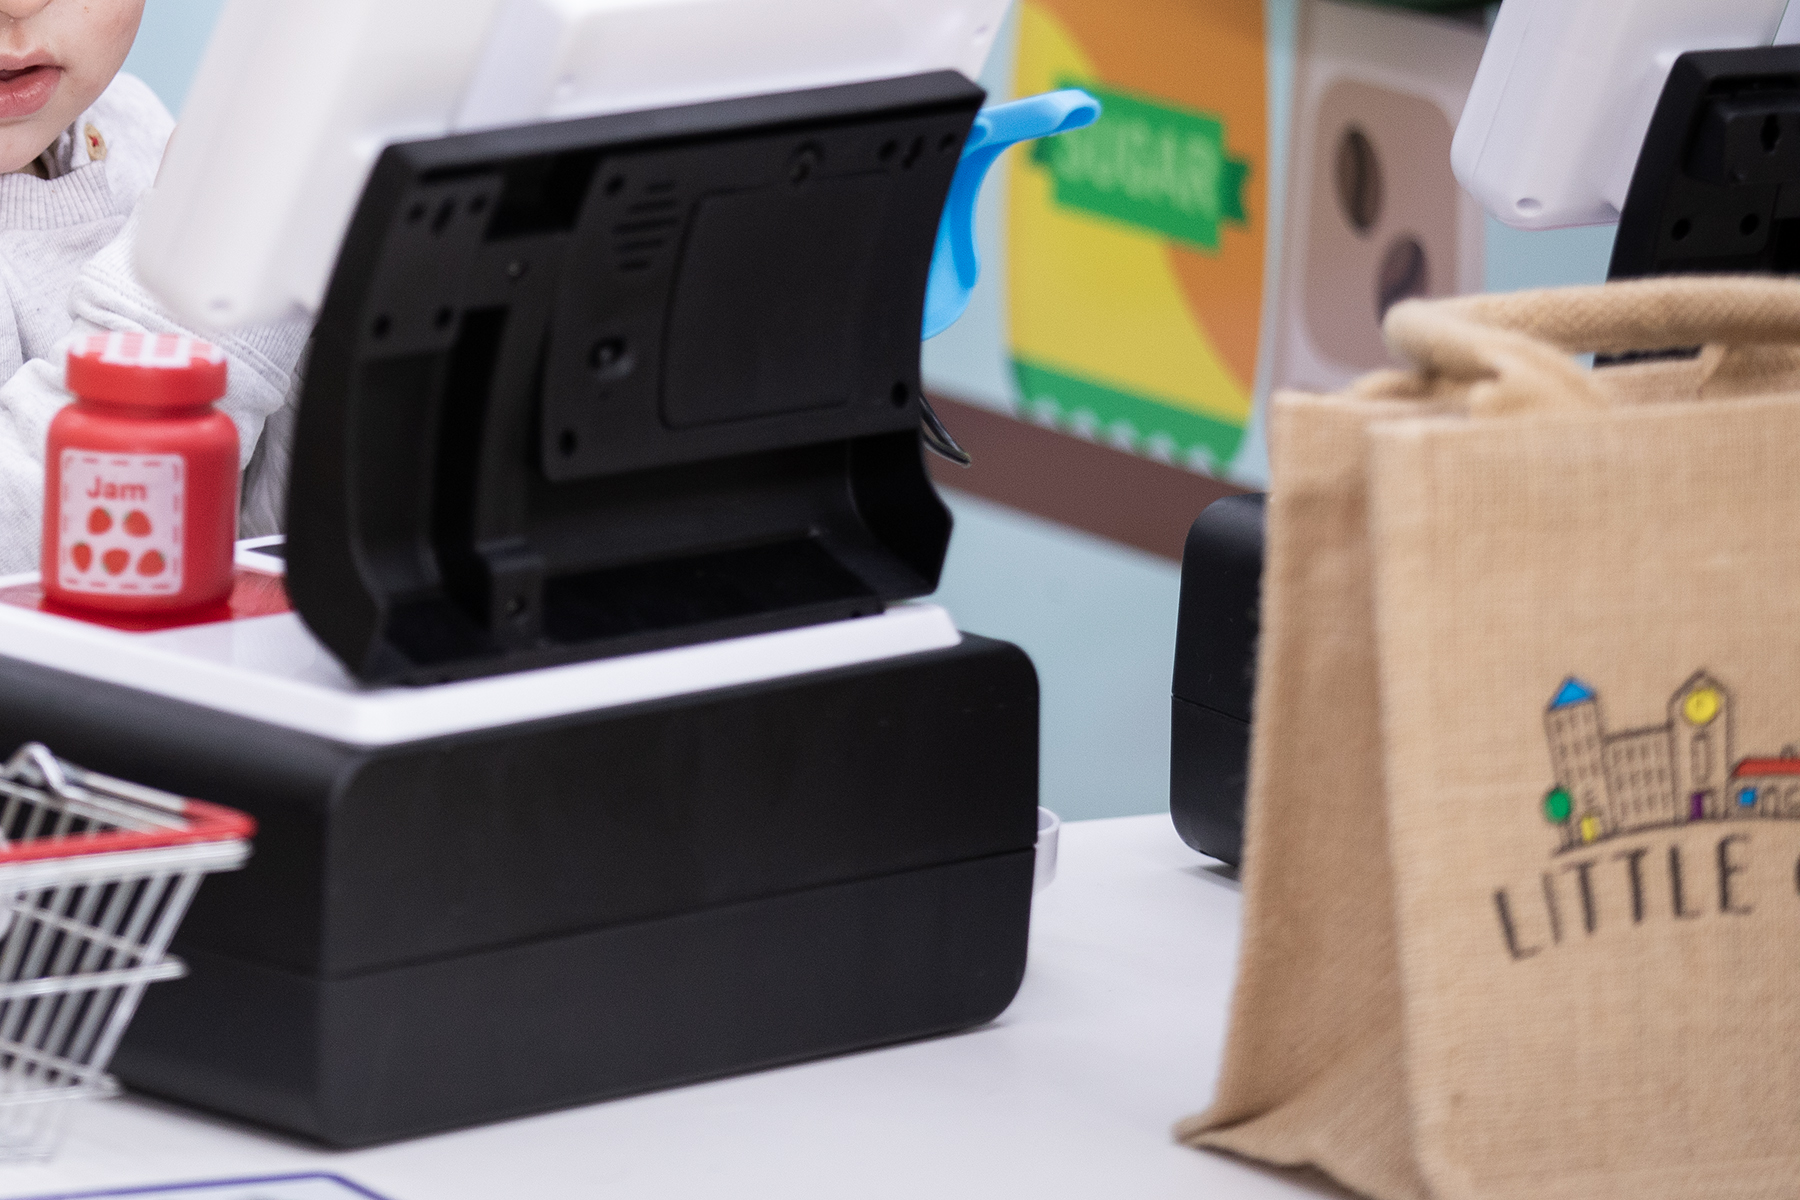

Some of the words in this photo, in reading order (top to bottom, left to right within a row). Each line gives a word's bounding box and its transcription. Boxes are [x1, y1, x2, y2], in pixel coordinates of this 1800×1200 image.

[1053, 116, 1220, 222] SUGAR
[85, 476, 147, 502] Jam
[1493, 833, 1756, 963] LITTLE
